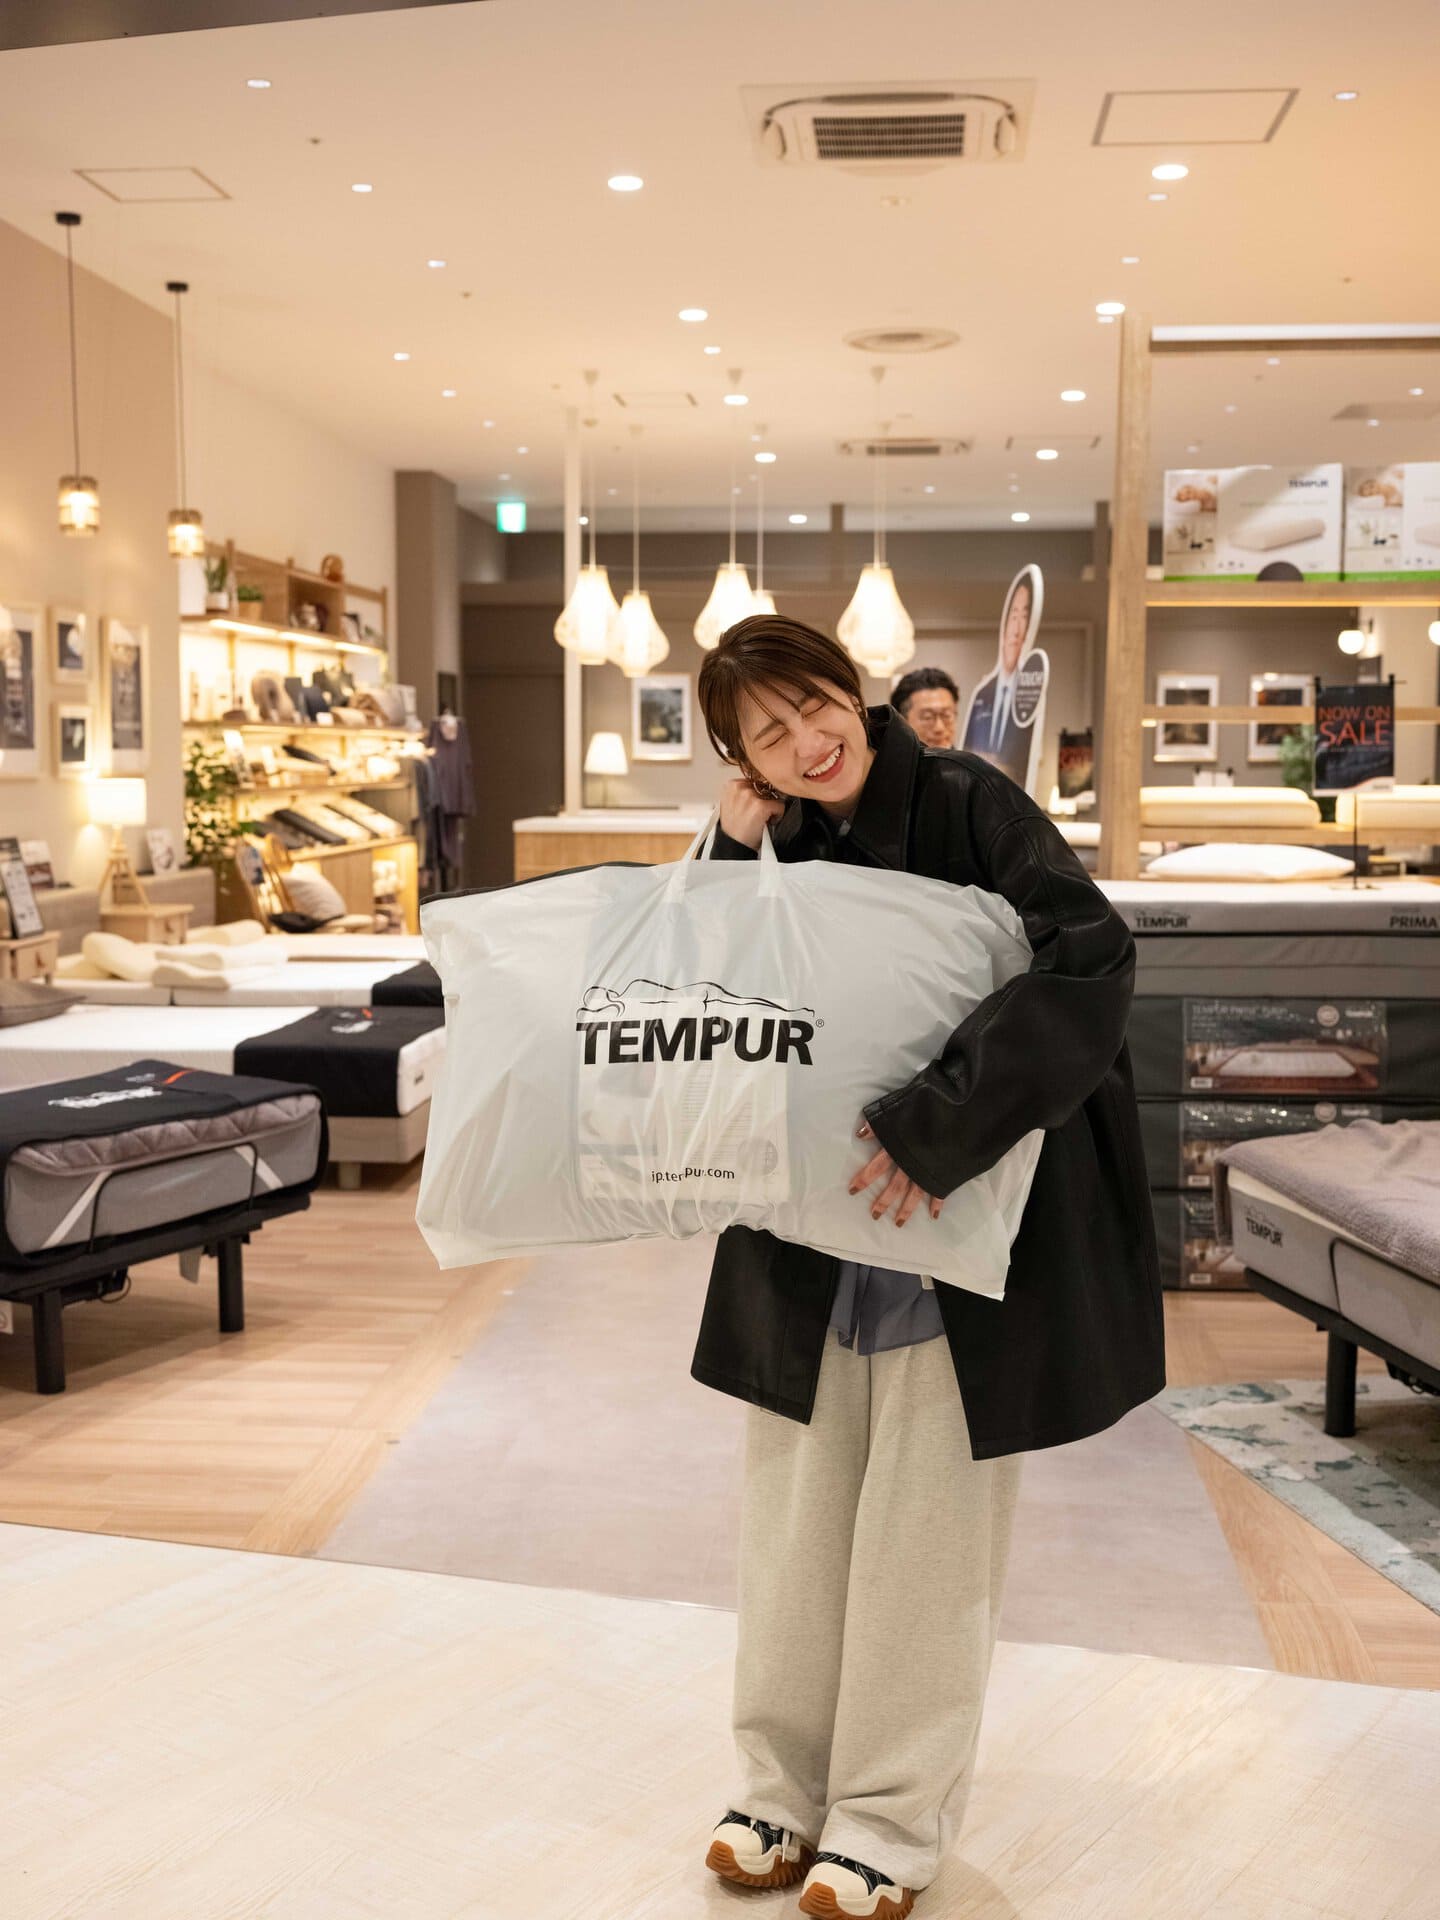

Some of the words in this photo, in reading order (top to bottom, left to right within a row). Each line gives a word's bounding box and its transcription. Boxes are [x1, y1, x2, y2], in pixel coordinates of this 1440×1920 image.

[1318, 705, 1360, 720] NOW
[1364, 704, 1391, 720] ON
[1319, 720, 1390, 745] SALE
[1135, 916, 1189, 928] TEMPUR
[1389, 915, 1438, 928] PRIMA
[1246, 1217, 1283, 1248] TEMPUR
